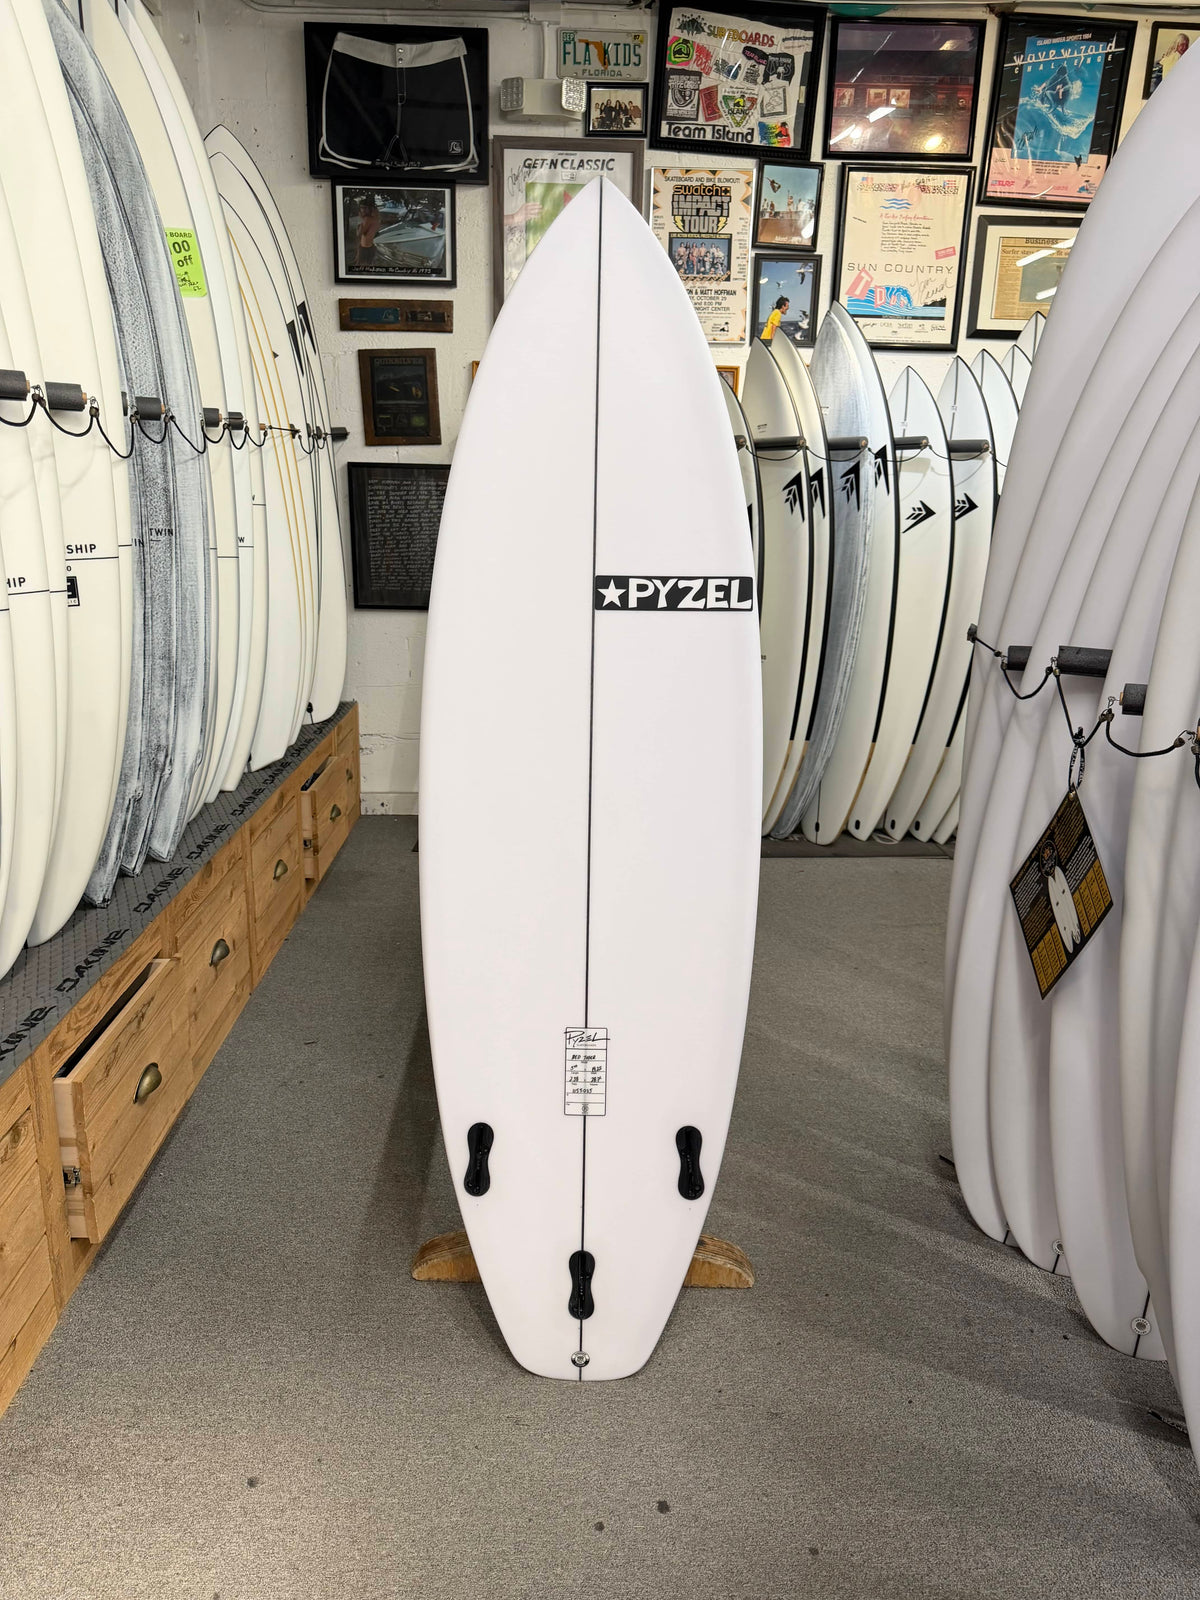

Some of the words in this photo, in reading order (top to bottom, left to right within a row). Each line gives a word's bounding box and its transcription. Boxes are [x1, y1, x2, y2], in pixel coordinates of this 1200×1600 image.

[707, 25, 775, 47] SURFBOARDS
[562, 42, 592, 66] FLA
[603, 43, 642, 67] KIDS
[582, 68, 622, 77] FLORIDA
[666, 122, 706, 139] Team
[711, 126, 754, 143] Island
[560, 158, 615, 171] CLASSIC
[673, 183, 721, 196] swatch
[683, 216, 718, 233] TOUR
[177, 254, 194, 268] off
[847, 263, 878, 271] SUN
[884, 264, 954, 274] COUNTRY
[149, 528, 174, 537] TWIN
[66, 544, 97, 555] SHIP
[628, 577, 752, 610] PYZEL
[186, 823, 231, 860] DAKINE
[133, 866, 189, 914] DAKINE
[55, 928, 130, 993] DAKINE
[0, 1005, 57, 1060] KINE
[564, 1030, 610, 1047] PYZEL
